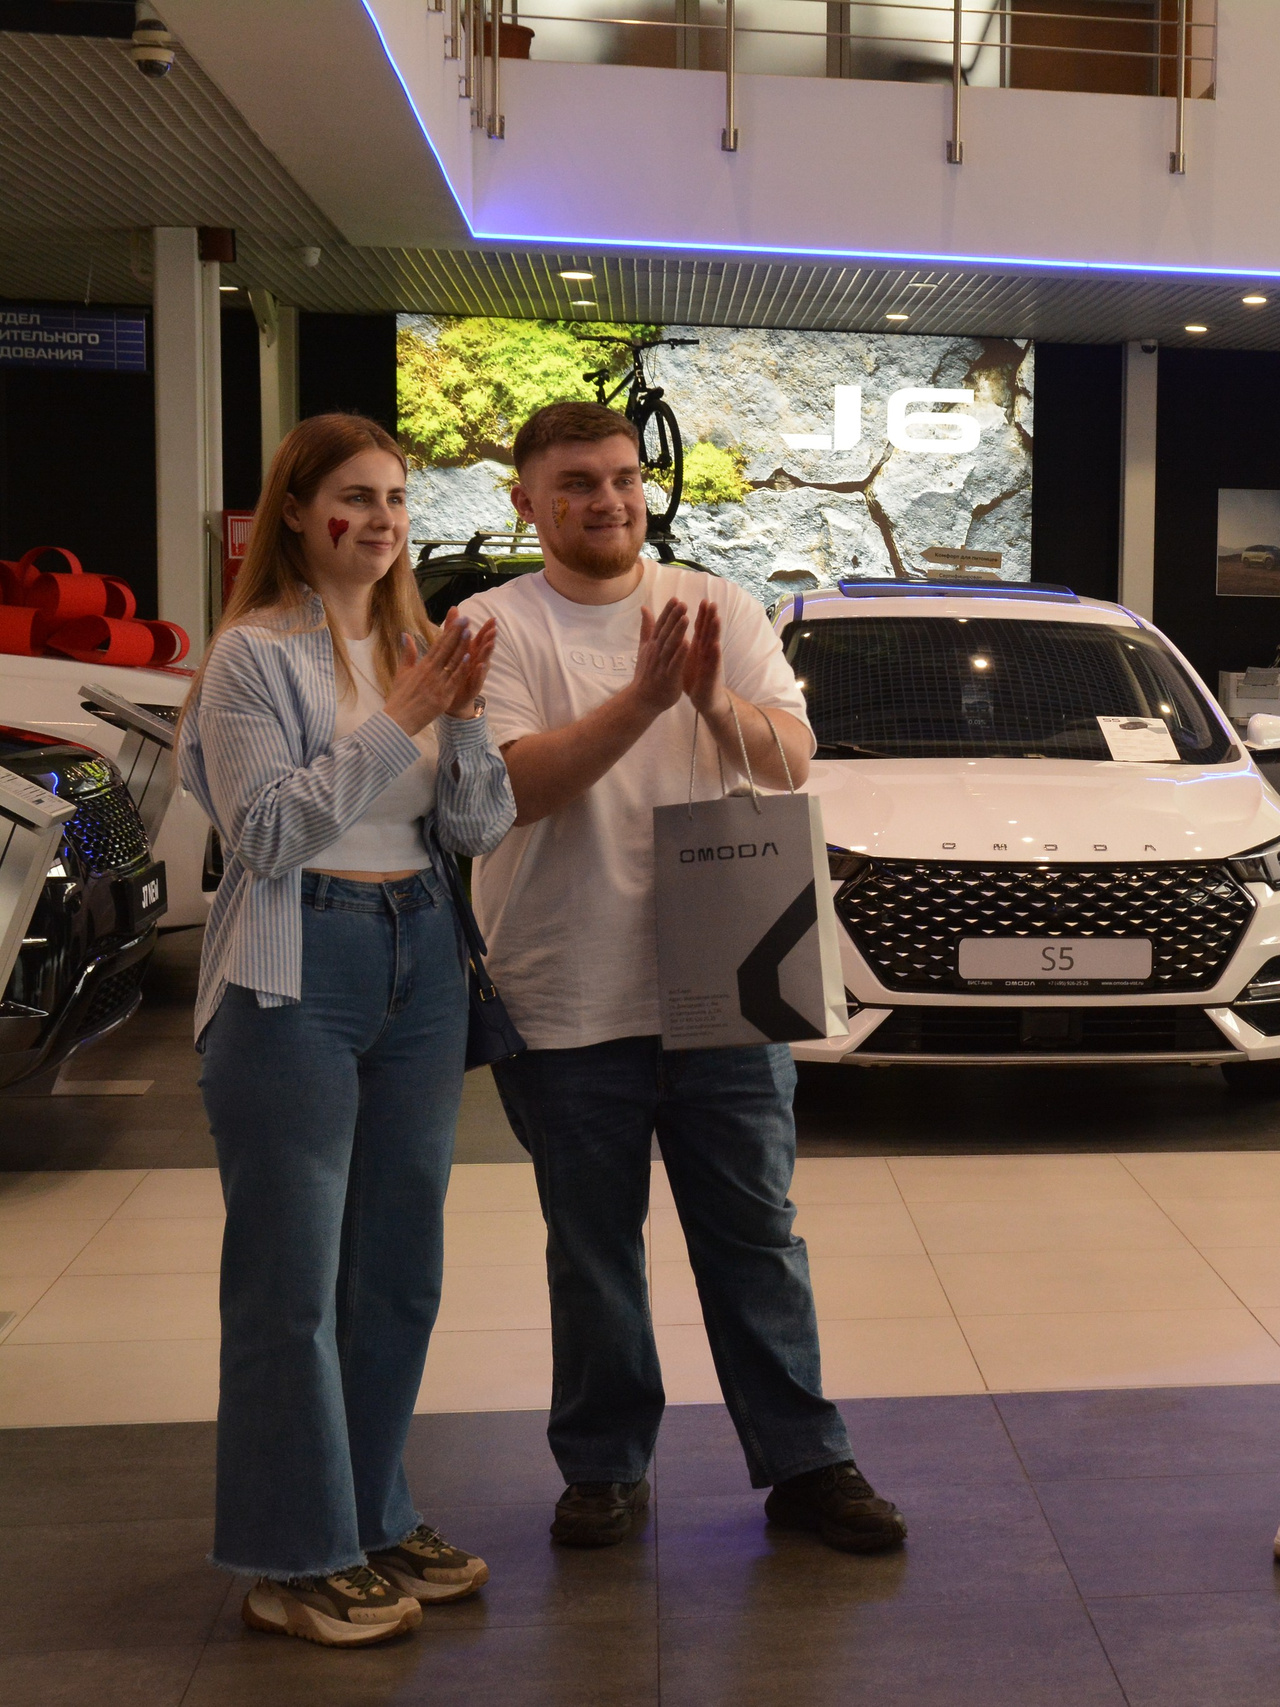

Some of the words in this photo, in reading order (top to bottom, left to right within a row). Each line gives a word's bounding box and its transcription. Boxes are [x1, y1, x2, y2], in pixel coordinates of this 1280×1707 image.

[780, 384, 981, 453] J6
[934, 552, 960, 560] Комфорт
[680, 842, 779, 864] OMODA
[942, 842, 1157, 851] OMODA
[1041, 946, 1075, 971] S5
